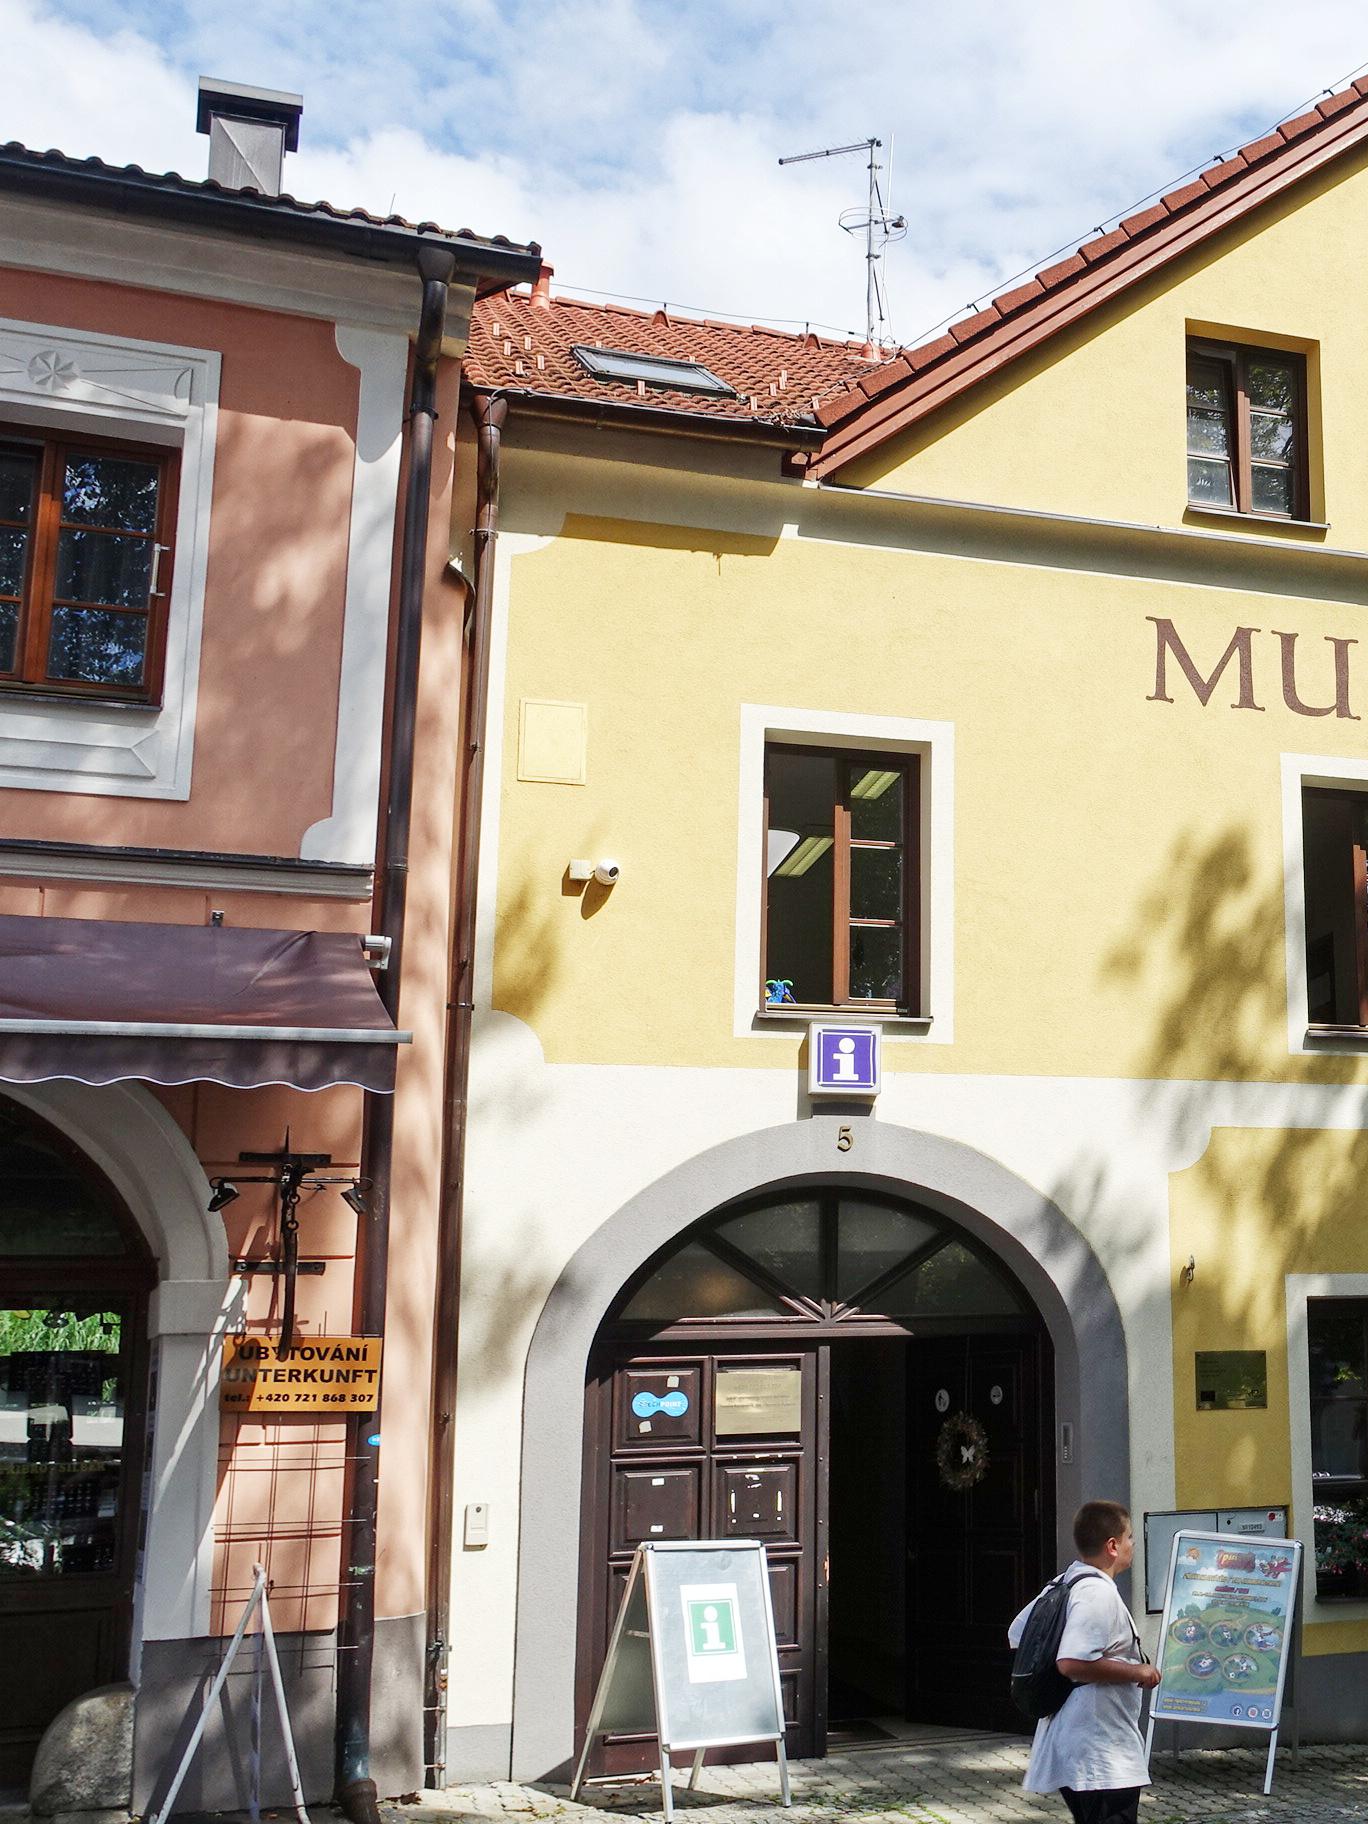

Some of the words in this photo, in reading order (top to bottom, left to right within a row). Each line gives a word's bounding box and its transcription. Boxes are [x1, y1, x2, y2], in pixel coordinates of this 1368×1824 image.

[836, 1123, 854, 1153] 5
[224, 1368, 378, 1384] UNTERKUNFT
[256, 1393, 290, 1403] +420
[294, 1393, 317, 1403] 721
[322, 1394, 347, 1403] 868
[350, 1394, 374, 1403] 307
